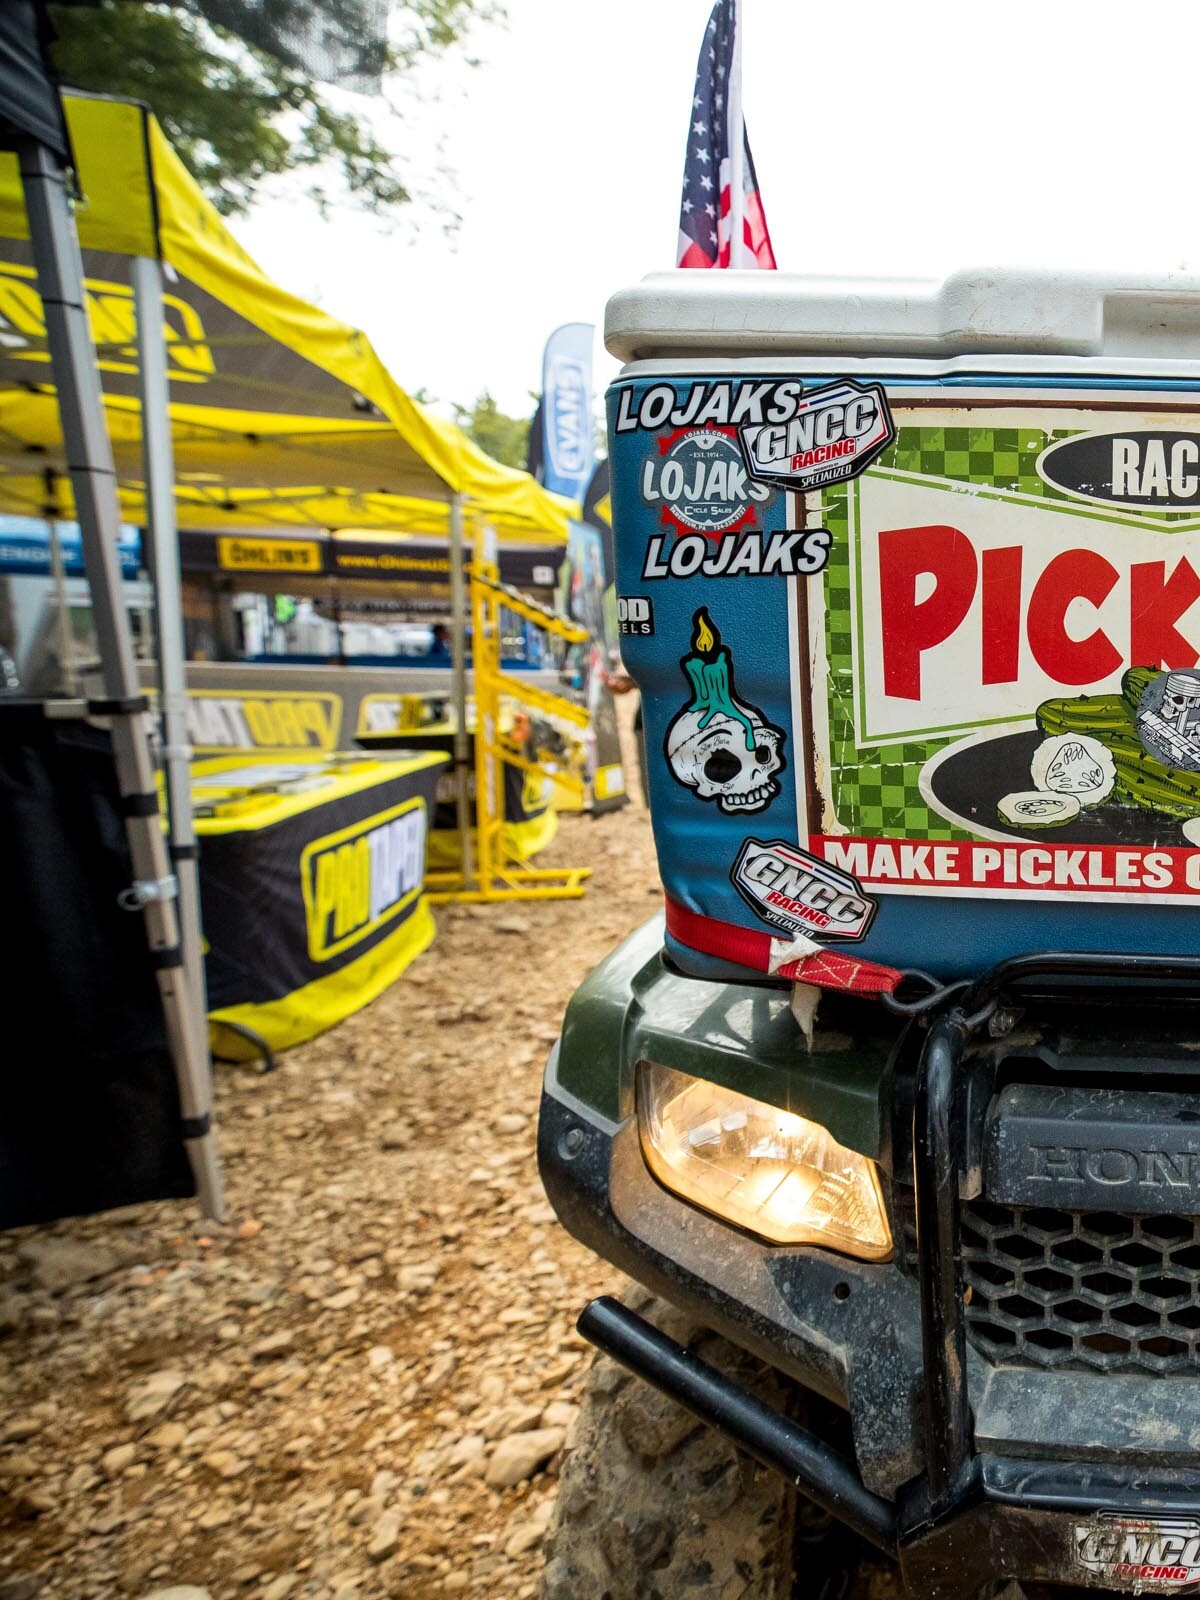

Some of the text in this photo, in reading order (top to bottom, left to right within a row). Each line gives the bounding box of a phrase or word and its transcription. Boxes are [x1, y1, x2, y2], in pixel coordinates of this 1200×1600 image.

[617, 382, 800, 431] LOJAKS
[683, 429, 728, 439] LOJAKS.COM
[756, 396, 877, 464] GNCC
[791, 438, 856, 472] RACING
[643, 460, 770, 501] LOJAKS
[801, 464, 852, 488] SPECIALIZED
[643, 532, 831, 577] LOJAKS
[824, 841, 957, 881] MAKE
[972, 846, 1175, 889] PICKLES
[744, 853, 866, 923] GNCC
[764, 911, 814, 938] SPECIALIZED
[765, 890, 832, 928] RACING
